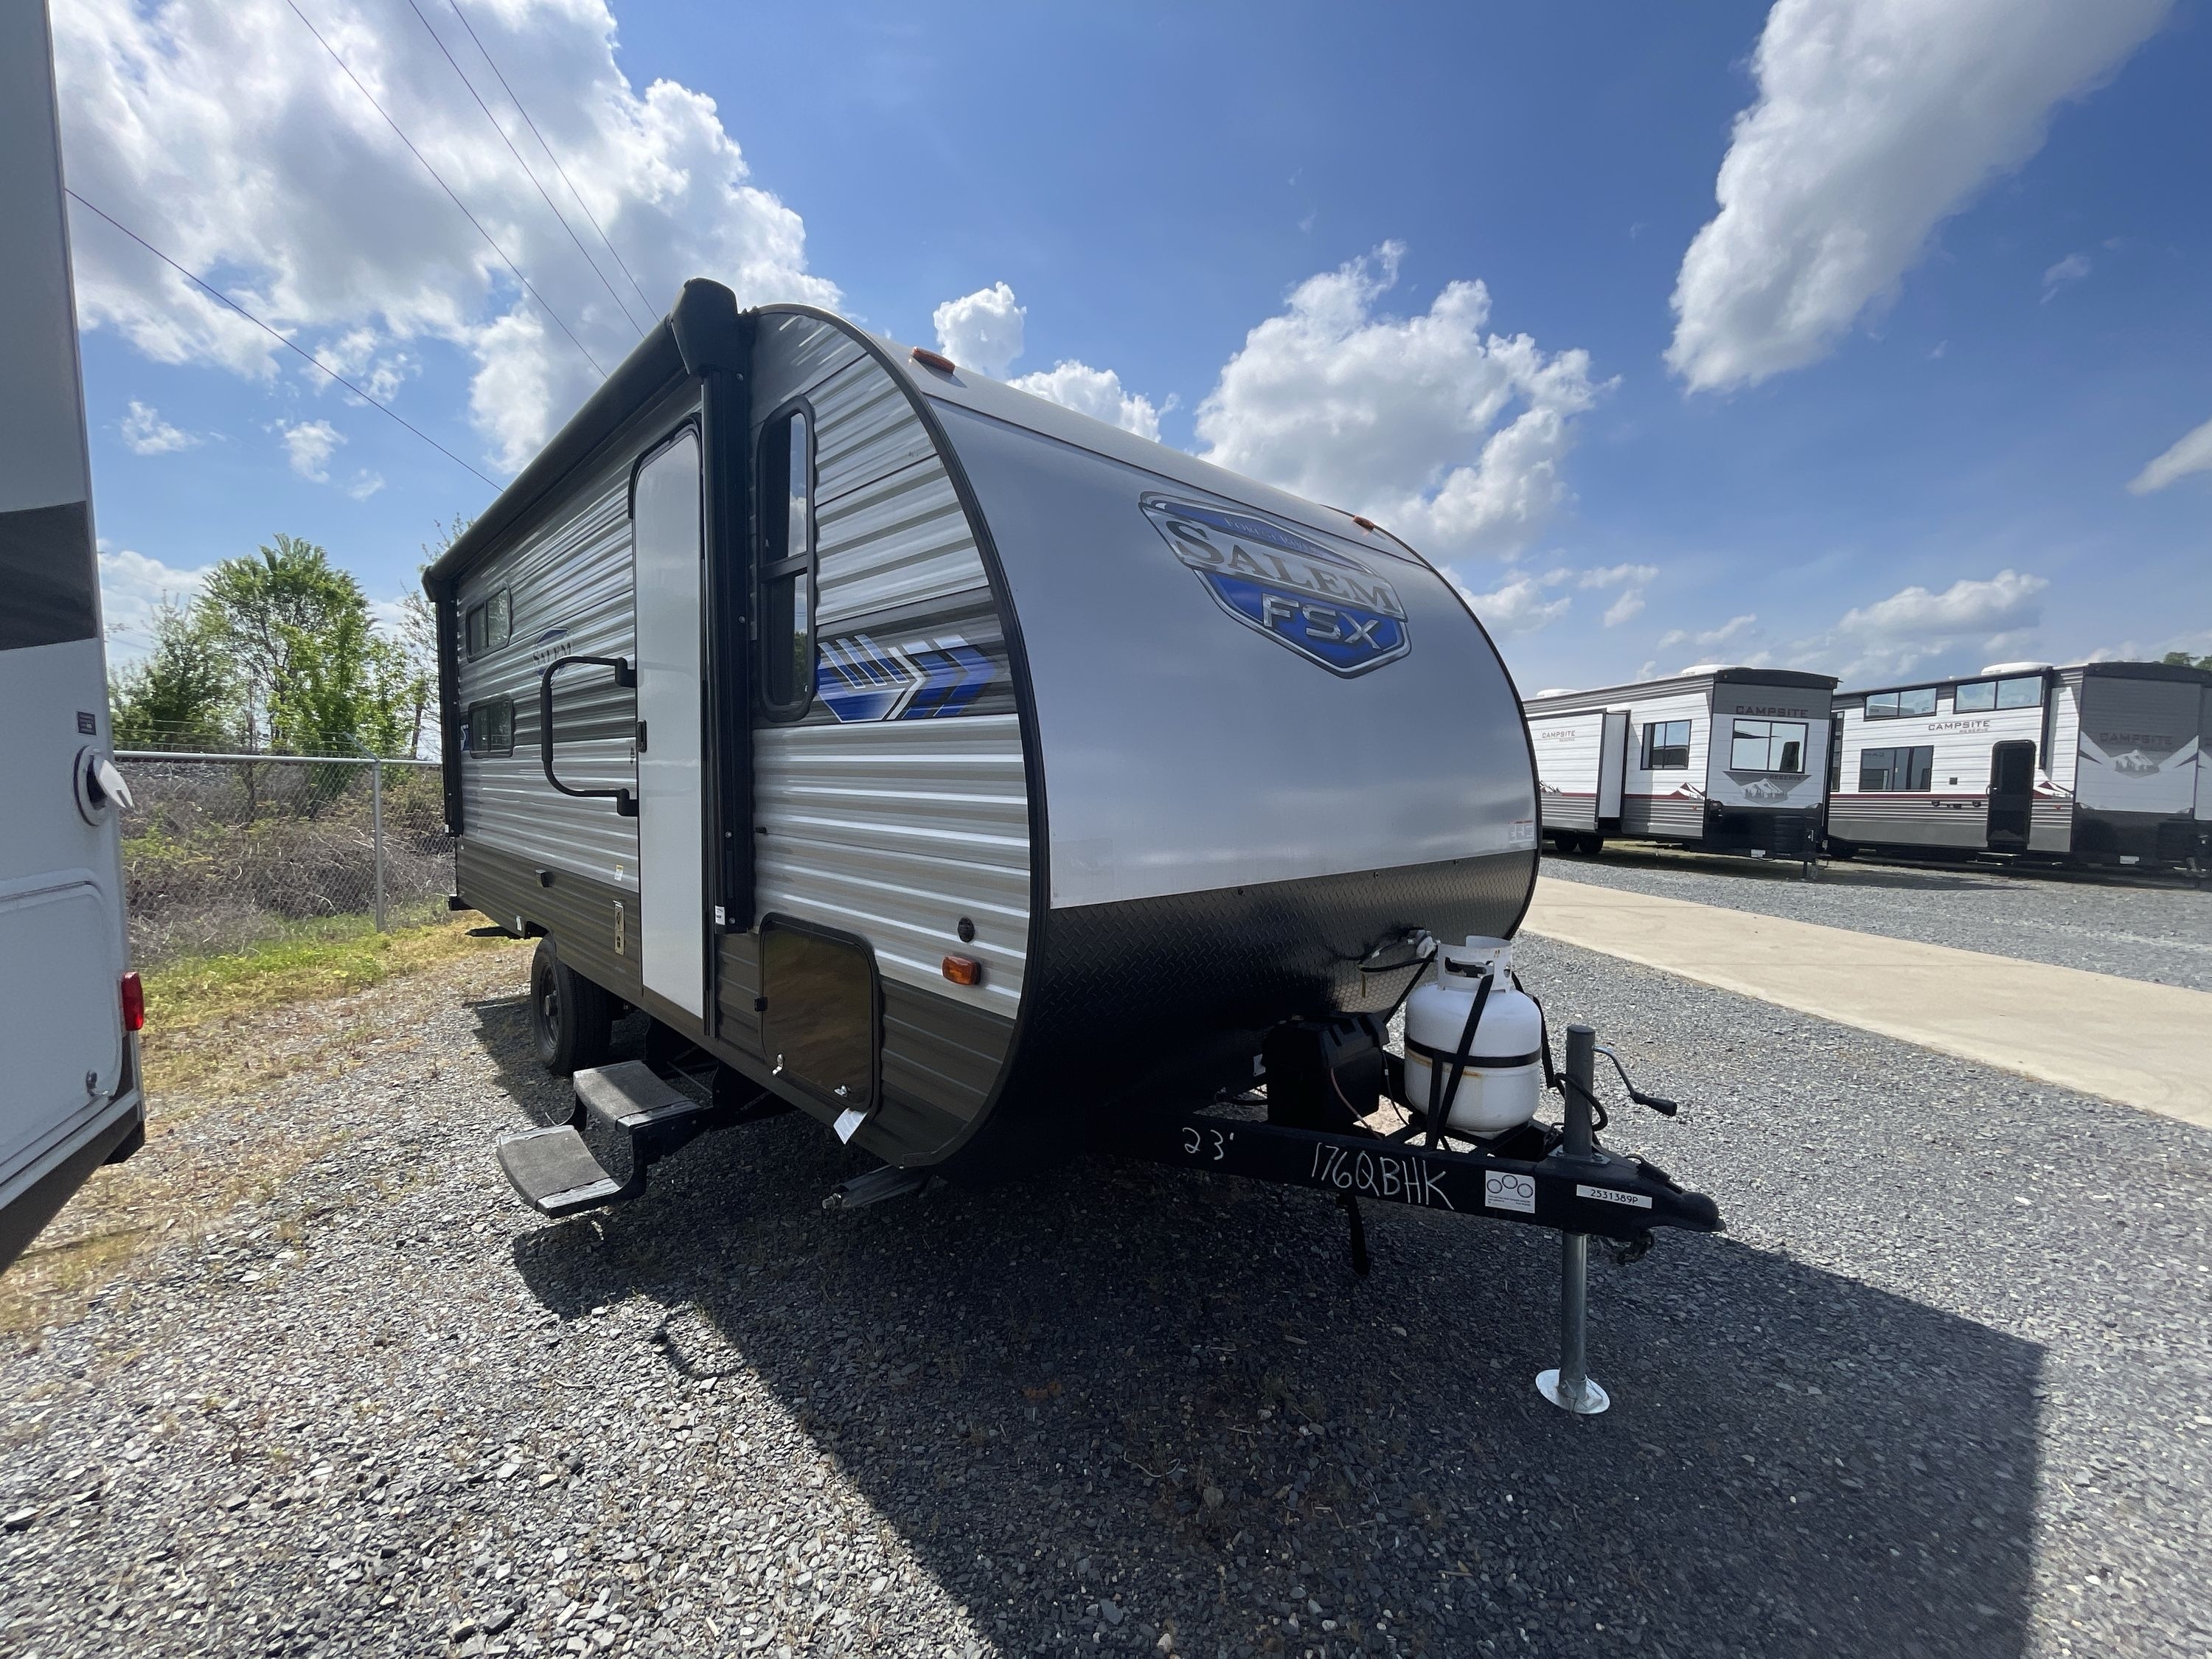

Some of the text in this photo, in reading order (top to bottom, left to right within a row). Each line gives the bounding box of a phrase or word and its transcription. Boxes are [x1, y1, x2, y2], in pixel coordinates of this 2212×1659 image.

[1166, 521, 1400, 613] SALEM
[1262, 593, 1385, 651] FSX
[1735, 706, 1809, 718] CAMPSITE
[1928, 720, 1991, 731] CAMPSITE
[1542, 731, 1576, 739] CAMPSITE
[1311, 1142, 1455, 1211] 176QBHK
[1590, 1189, 1638, 1204] 2531389P
